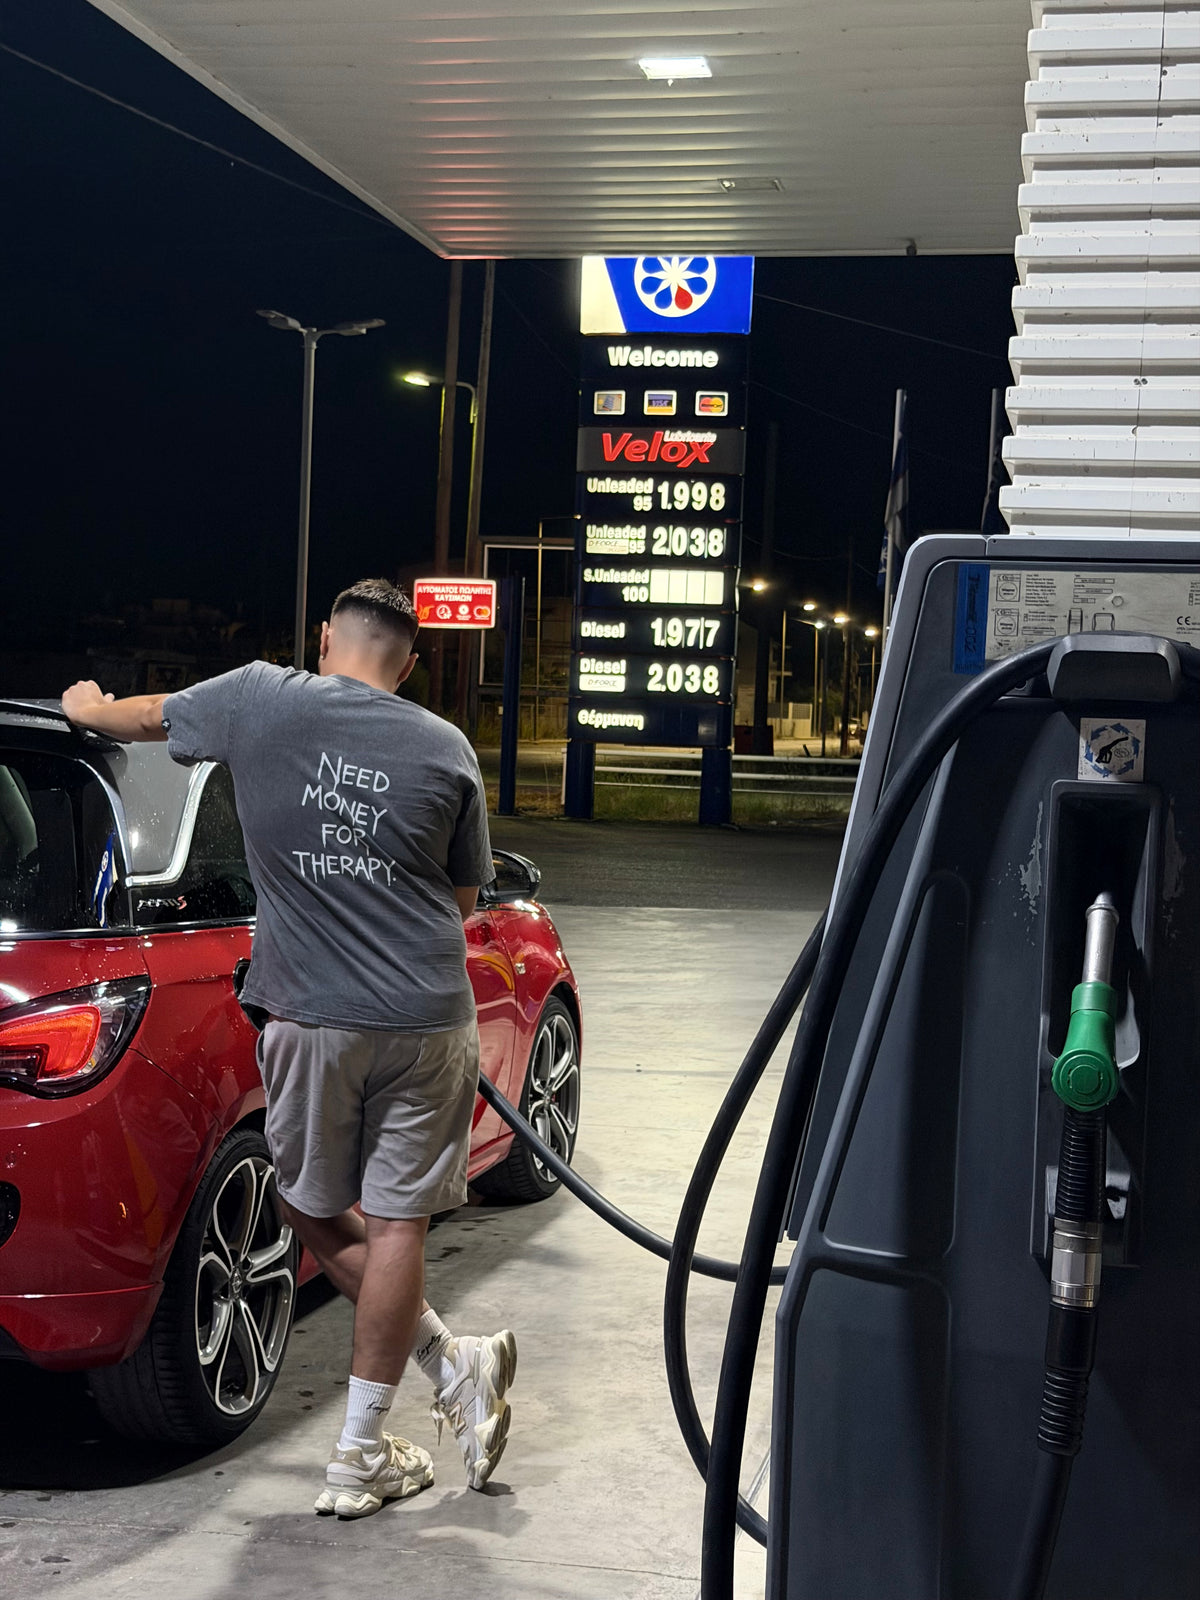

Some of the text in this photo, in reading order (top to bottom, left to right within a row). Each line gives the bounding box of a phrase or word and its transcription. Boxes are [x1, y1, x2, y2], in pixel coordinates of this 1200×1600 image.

[608, 346, 719, 367] Welcome
[602, 431, 713, 468] Velox
[587, 478, 654, 494] Unleaded
[633, 496, 652, 511] 95
[658, 481, 725, 511] 1.998
[586, 525, 646, 539] Unleaded
[629, 540, 645, 553] 95
[584, 568, 649, 584] S.Unleaded
[622, 586, 648, 602] 100
[581, 621, 625, 638] Diesel
[651, 617, 720, 648] 1.977
[580, 658, 626, 675] Diesel
[317, 752, 390, 793] NEED
[302, 784, 387, 836] MONEY
[321, 823, 370, 856] FOR
